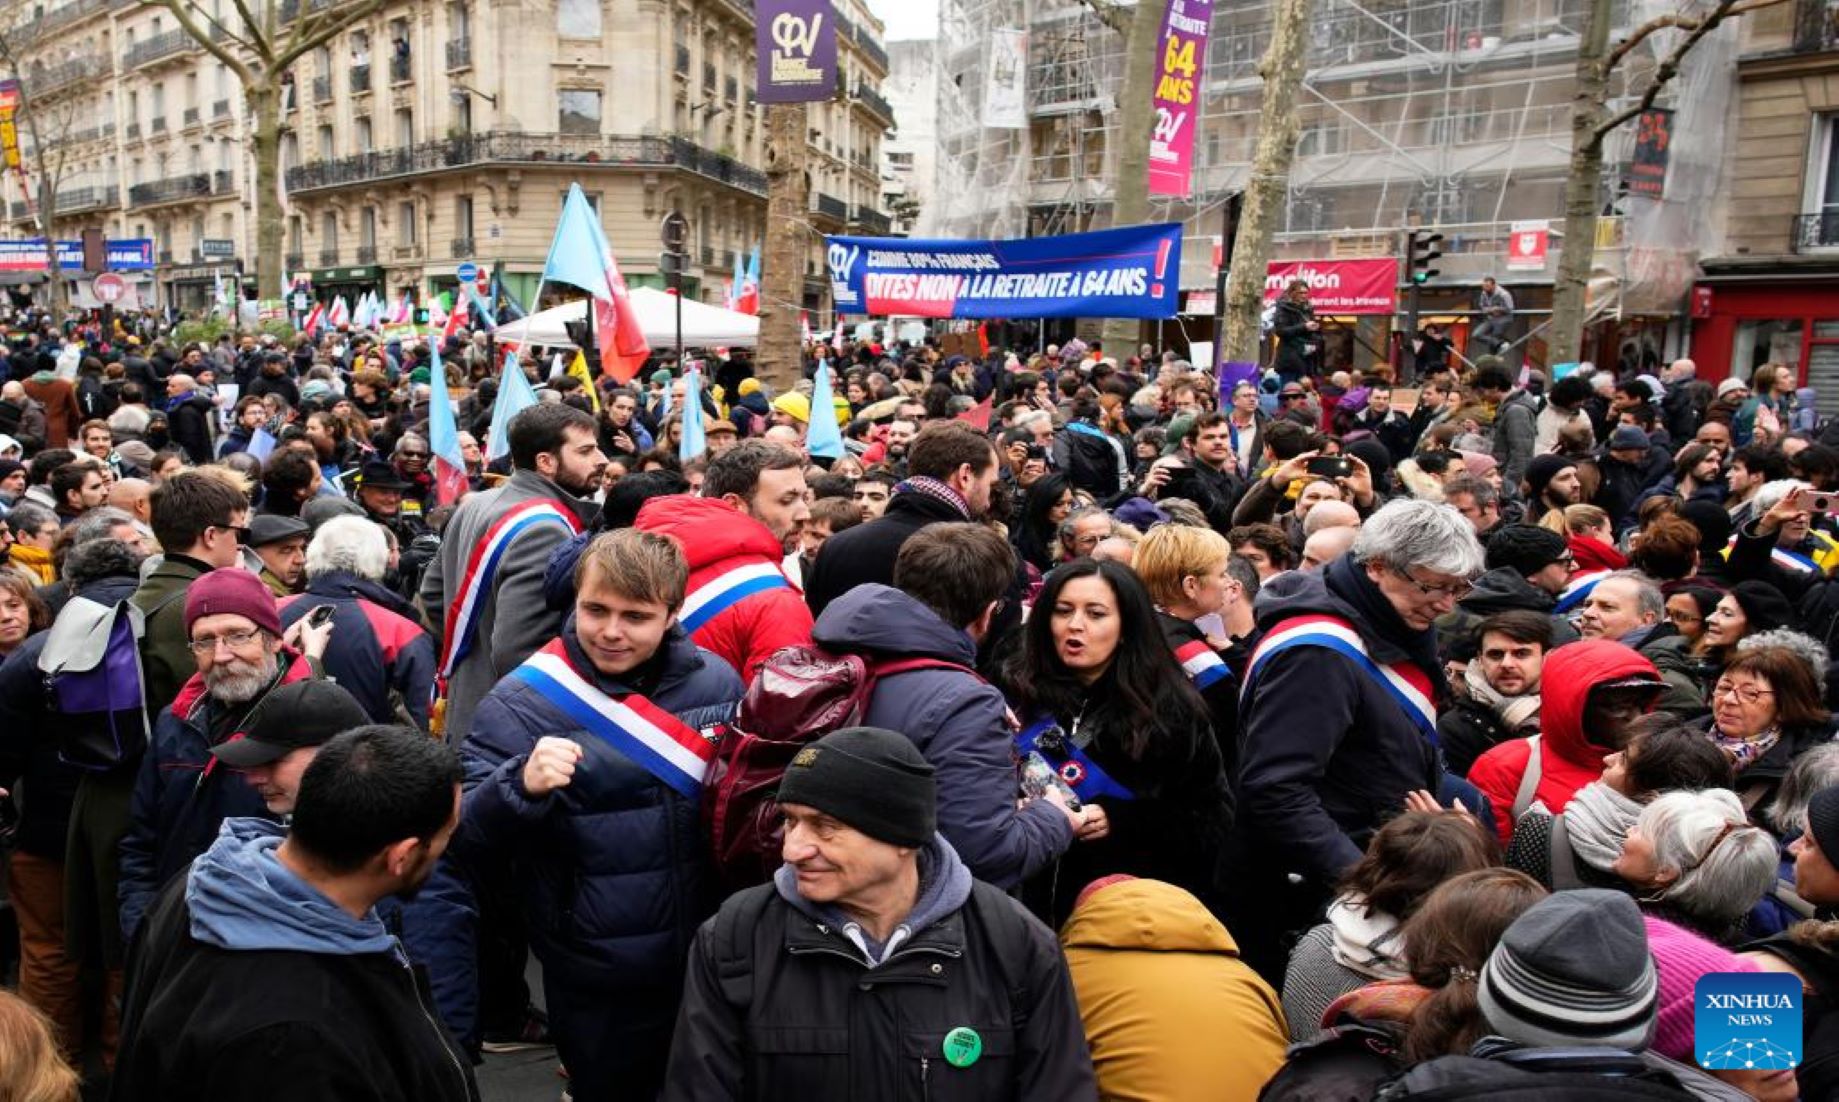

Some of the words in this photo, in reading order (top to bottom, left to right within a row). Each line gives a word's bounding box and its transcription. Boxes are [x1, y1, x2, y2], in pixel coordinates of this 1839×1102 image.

[1163, 34, 1198, 78] 64
[1154, 74, 1195, 105] ANS
[936, 253, 1000, 272] FRANÇAIS
[866, 273, 915, 299] DITES
[914, 274, 961, 300] NON
[970, 273, 994, 298] LA
[992, 272, 1072, 298] RETRAITE
[1081, 270, 1108, 297] 64
[1106, 268, 1148, 297] ANS
